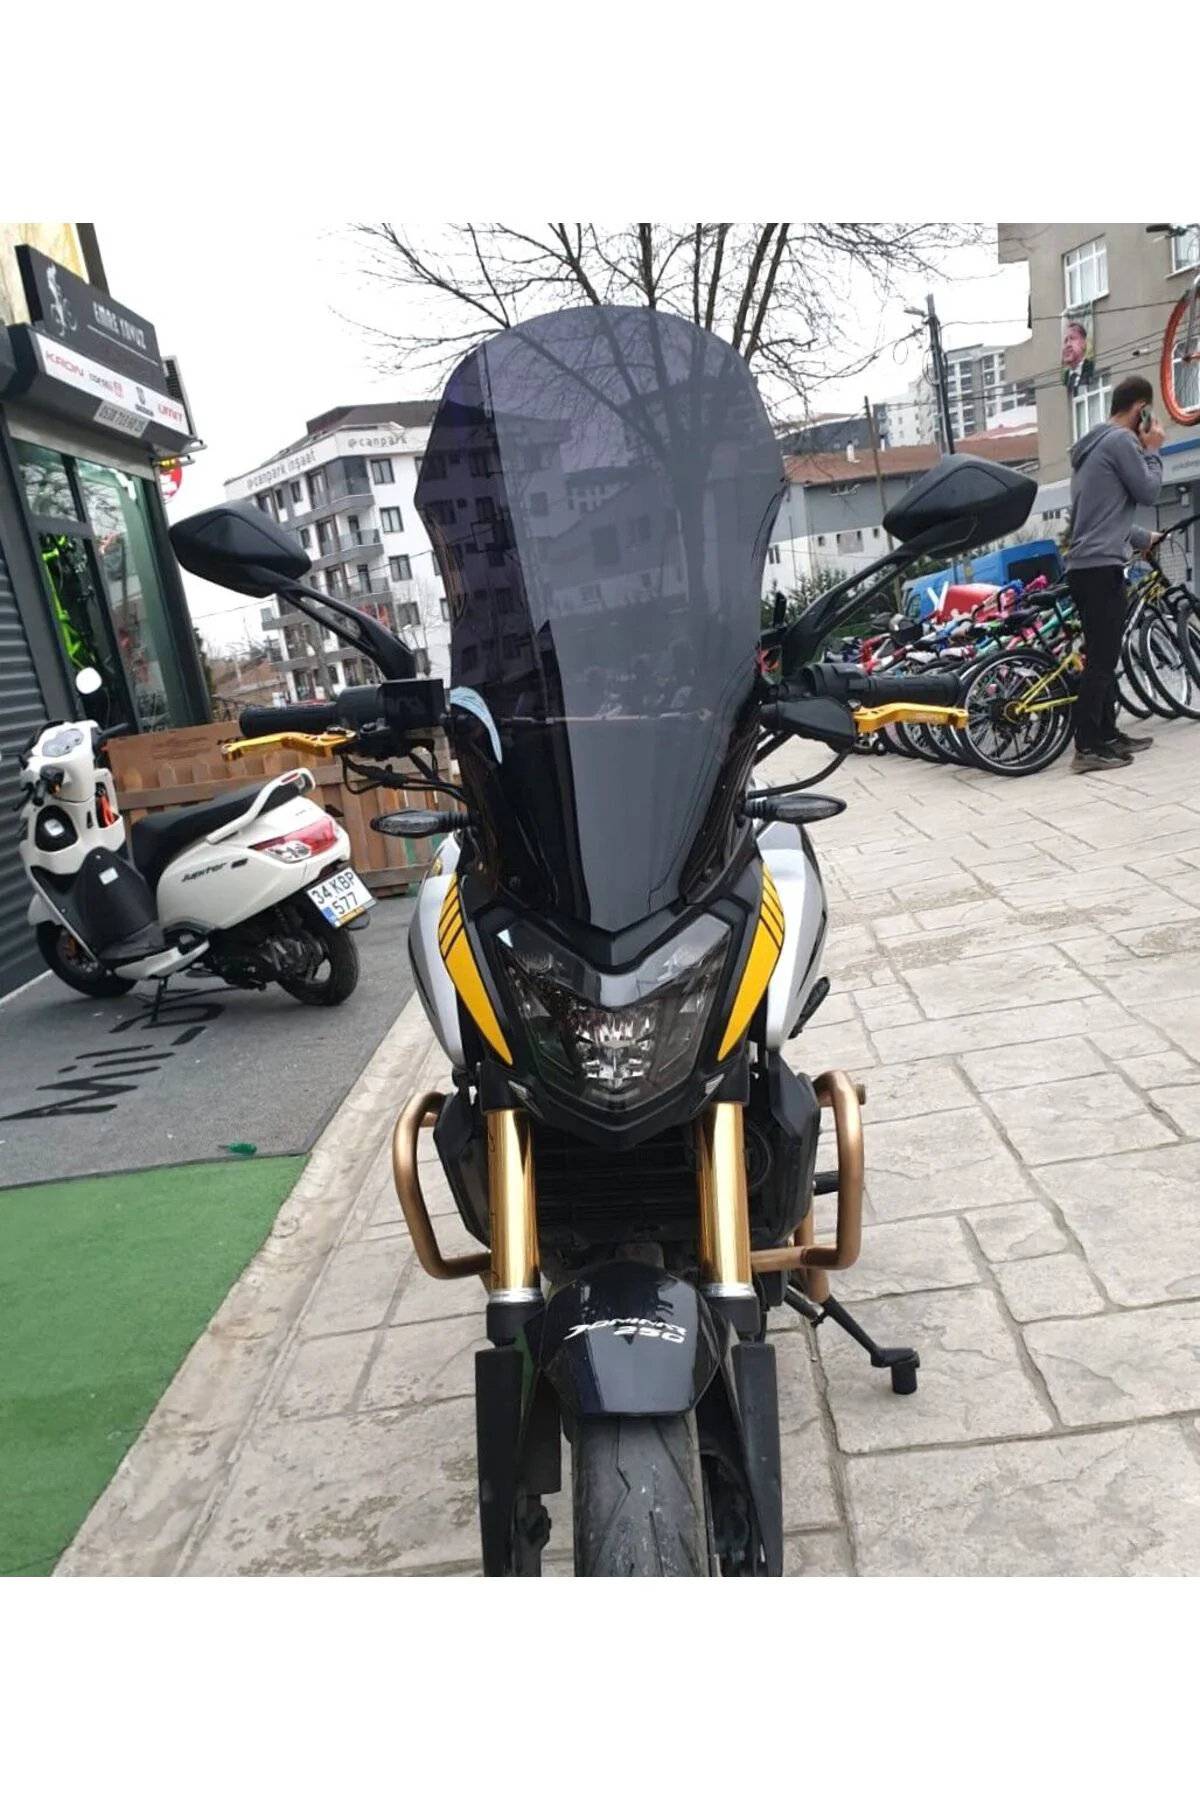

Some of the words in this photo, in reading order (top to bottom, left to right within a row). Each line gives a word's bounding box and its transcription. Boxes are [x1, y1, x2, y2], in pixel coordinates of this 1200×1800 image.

[311, 885, 332, 904] 34
[328, 871, 354, 894] KBP
[332, 892, 358, 914] 577
